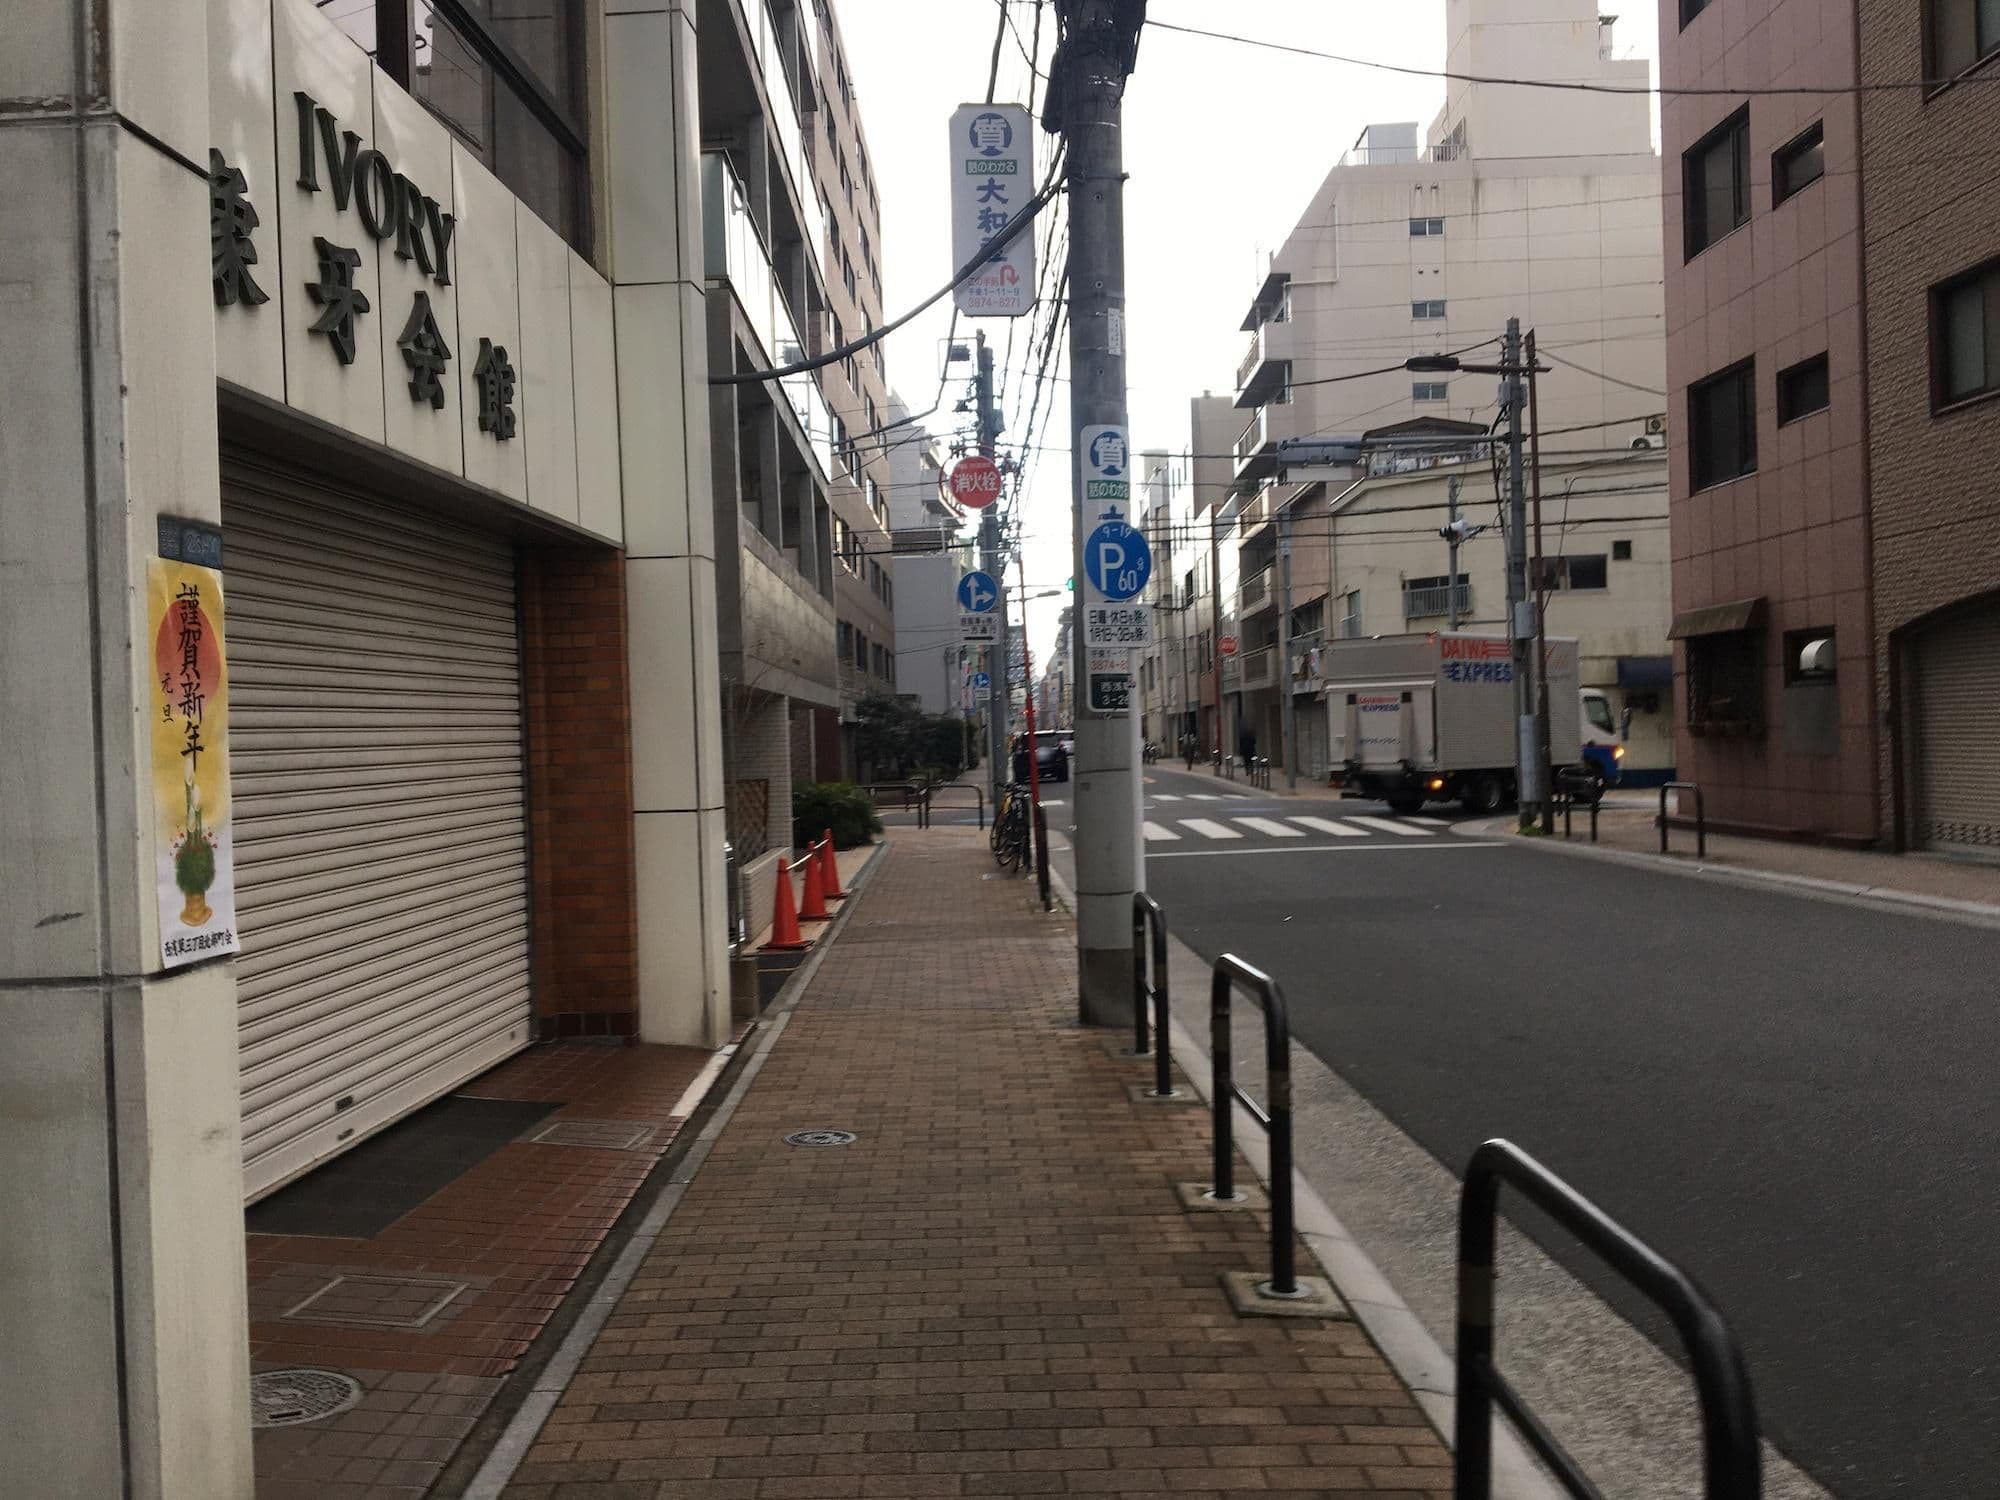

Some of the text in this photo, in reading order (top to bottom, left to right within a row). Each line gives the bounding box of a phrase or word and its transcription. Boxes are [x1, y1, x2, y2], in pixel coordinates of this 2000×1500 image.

[294, 91, 457, 286] IVORY
[953, 471, 999, 493] 消火栓
[1099, 542, 1126, 593] P
[1440, 638, 1492, 658] DAIWA
[1446, 662, 1513, 682] EXPRES
[161, 672, 174, 722] 元旦
[175, 583, 206, 771] 謹賀新年
